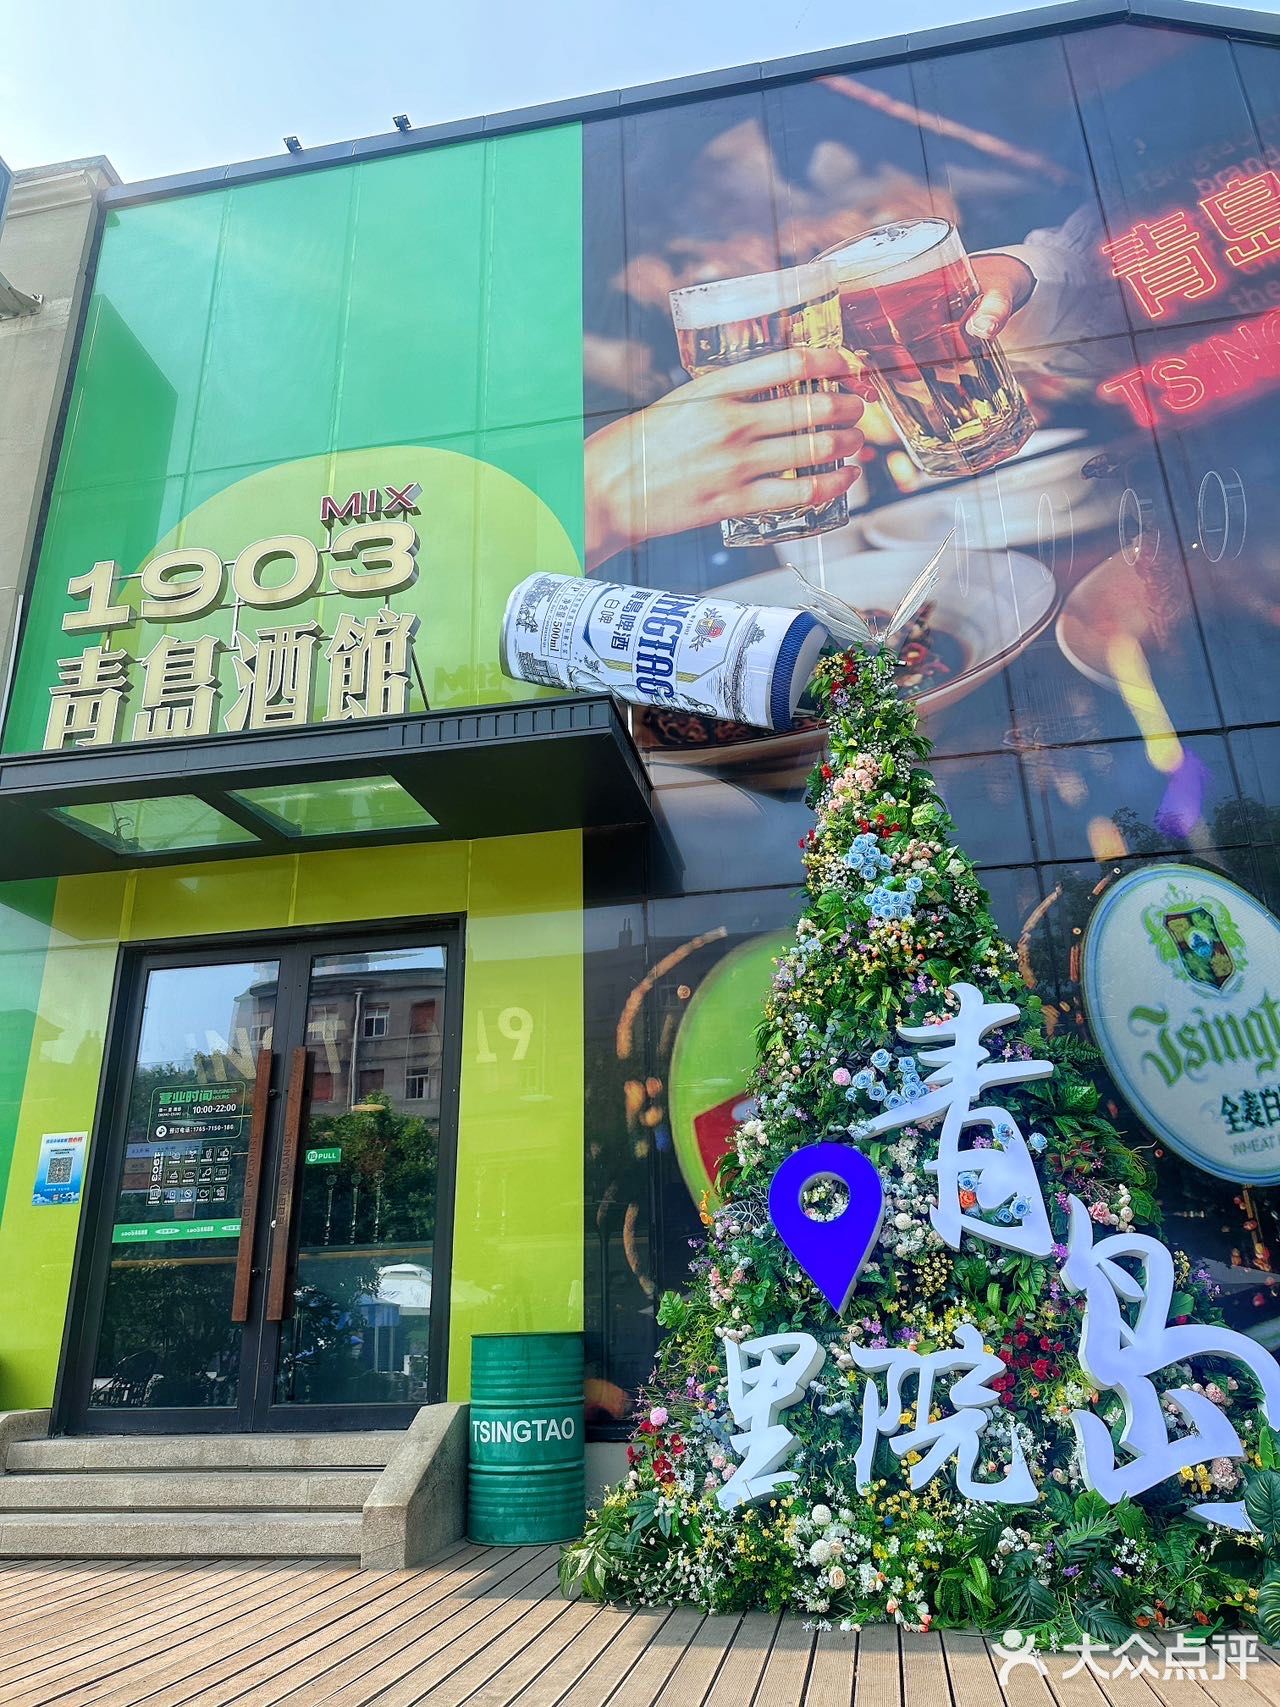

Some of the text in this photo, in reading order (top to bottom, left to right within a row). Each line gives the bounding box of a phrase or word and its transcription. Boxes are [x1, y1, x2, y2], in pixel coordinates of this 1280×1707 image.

[320, 482, 423, 527] MIX
[61, 521, 420, 633] 1903
[192, 1103, 237, 1115] 10:00-22:00
[318, 1152, 337, 1160] PULL
[472, 1416, 575, 1443] TSINGTAO
[717, 1323, 1040, 1511] 里院
